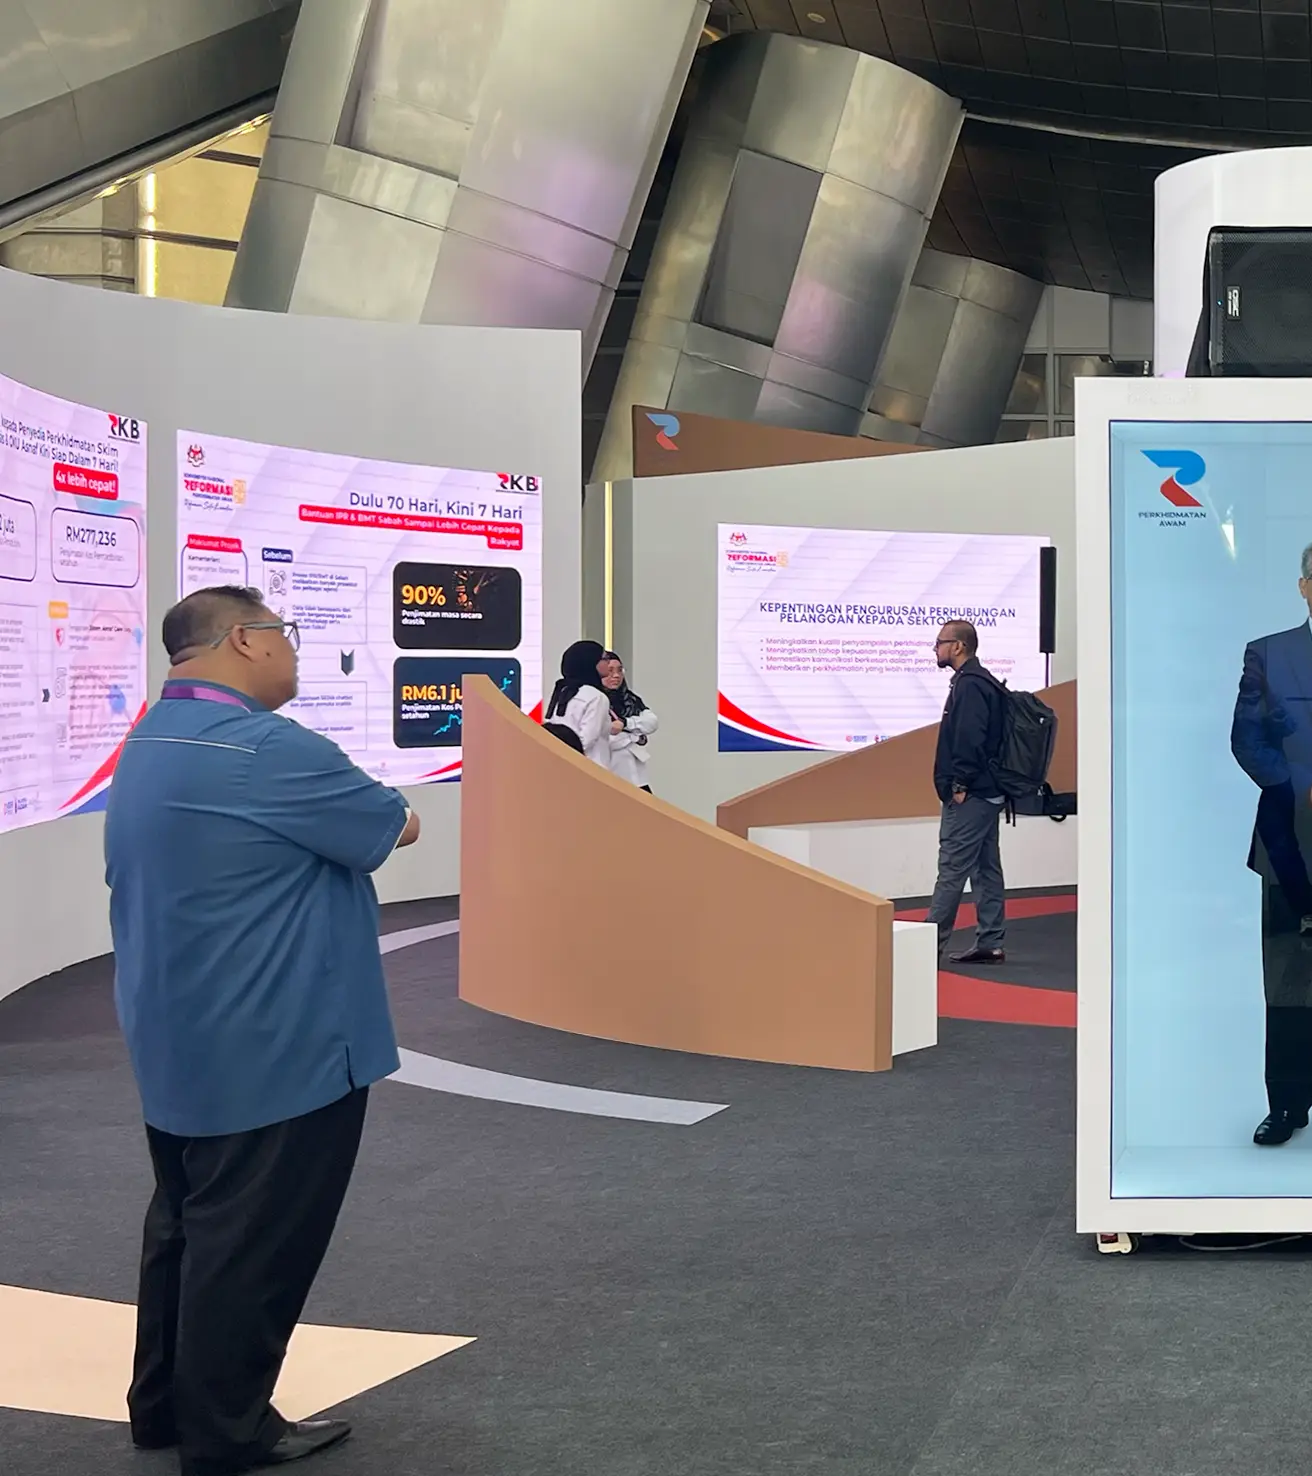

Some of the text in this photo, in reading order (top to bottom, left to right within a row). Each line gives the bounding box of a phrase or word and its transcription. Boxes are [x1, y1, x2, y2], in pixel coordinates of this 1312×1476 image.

[46, 429, 96, 453] Perkhidmatan
[97, 442, 119, 458] Skim
[51, 447, 67, 464] Siap
[68, 452, 91, 468] Dalam
[56, 470, 117, 494] 4x lebih cepat!
[350, 492, 522, 519] Dulu 70 Hari, Kini 7 Hari
[301, 508, 335, 519] Bantuan
[378, 515, 403, 526] Sabah
[404, 517, 435, 529] Sampai
[436, 520, 460, 530] Lebih
[461, 522, 486, 533] Cepat
[488, 524, 520, 535] Kepada
[66, 525, 117, 547] RM277,236
[264, 550, 292, 561] Sebelum
[402, 584, 447, 607] 90%
[402, 609, 483, 620] Penjimatan masa secara
[760, 602, 1016, 618] KEPENTINGAN PENGURUSAN PERHUBUNGAN
[780, 613, 854, 624] PELANGGAN
[857, 614, 904, 625] KEPADA
[959, 617, 997, 627] WAM
[402, 684, 447, 701] RM6.1
[402, 703, 454, 713] Penjimatan Kos
[402, 712, 430, 720] setahun
